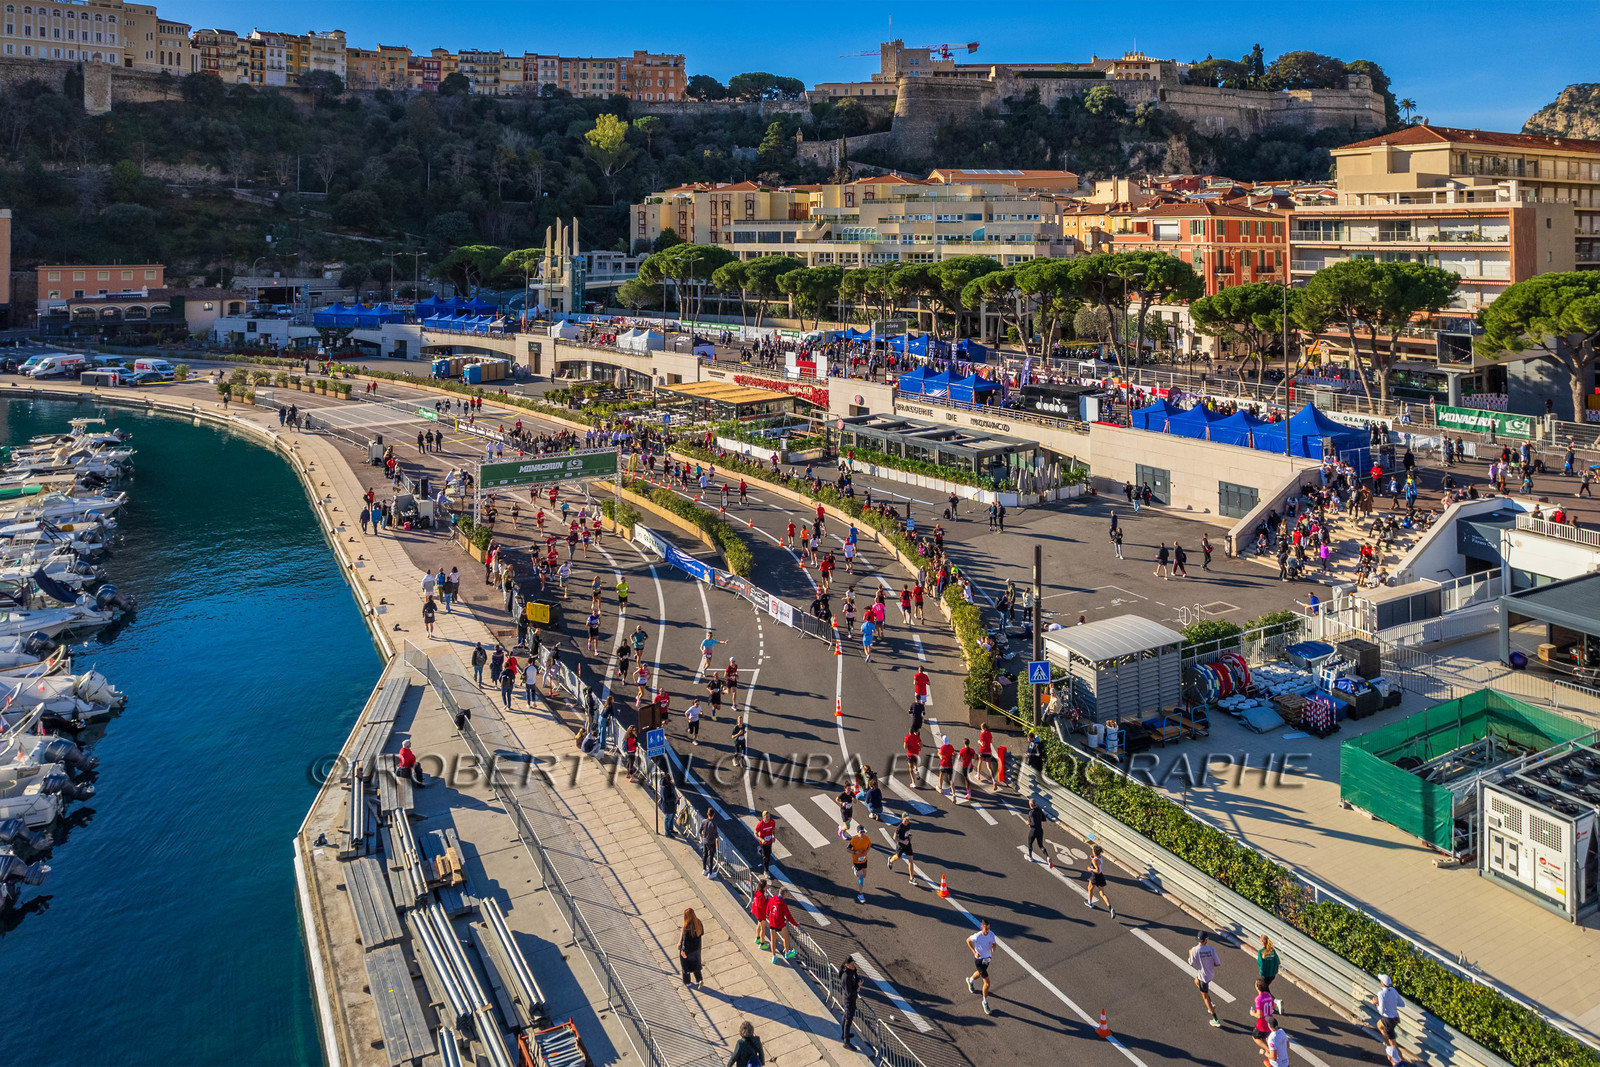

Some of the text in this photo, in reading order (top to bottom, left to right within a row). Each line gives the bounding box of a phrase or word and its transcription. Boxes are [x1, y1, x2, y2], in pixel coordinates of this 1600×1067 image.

[895, 403, 1010, 432] BRASSERIE DE MONACO
[519, 461, 564, 473] MONACORUN
